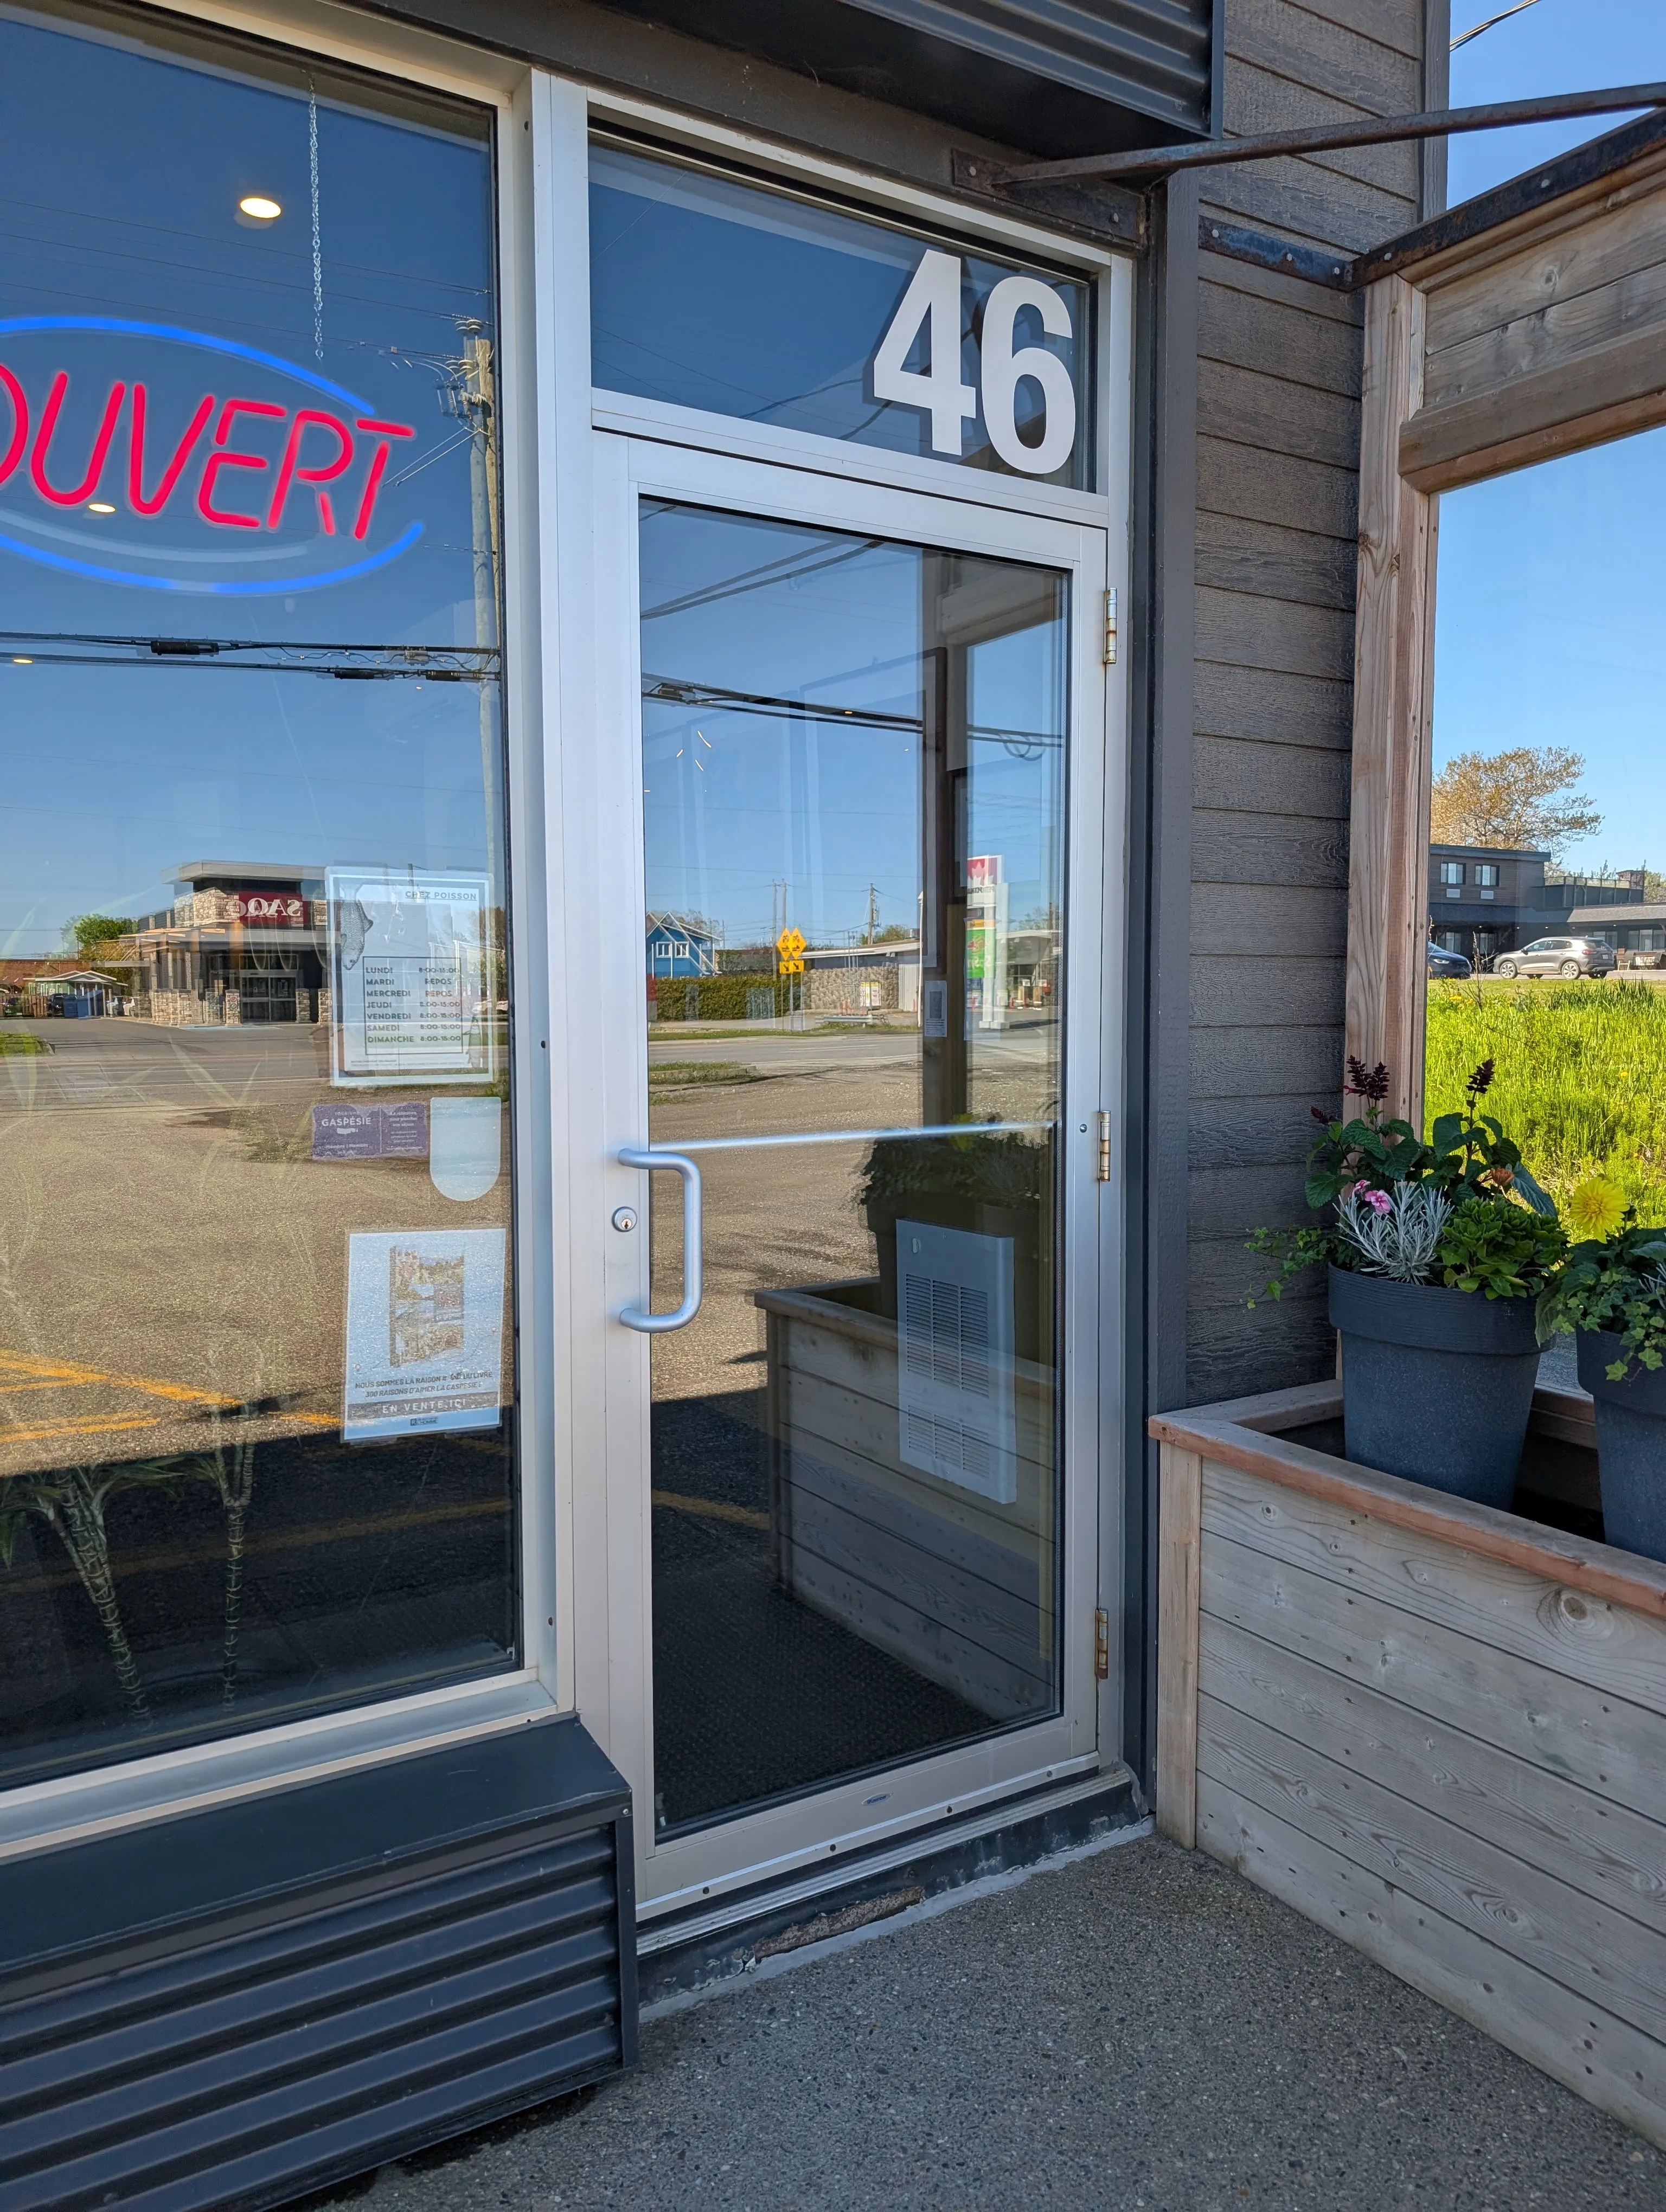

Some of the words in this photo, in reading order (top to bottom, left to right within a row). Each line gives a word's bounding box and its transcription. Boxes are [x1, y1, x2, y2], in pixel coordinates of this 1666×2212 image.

[874, 249, 1076, 474] 46
[321, 1116, 371, 1127] GASPÉSIE
[376, 1379, 405, 1387] SOMMES
[379, 1388, 408, 1397] RAISONS
[382, 1405, 398, 1414] EN
[404, 1400, 444, 1411] VENTE
[448, 1399, 465, 1409] ICI
